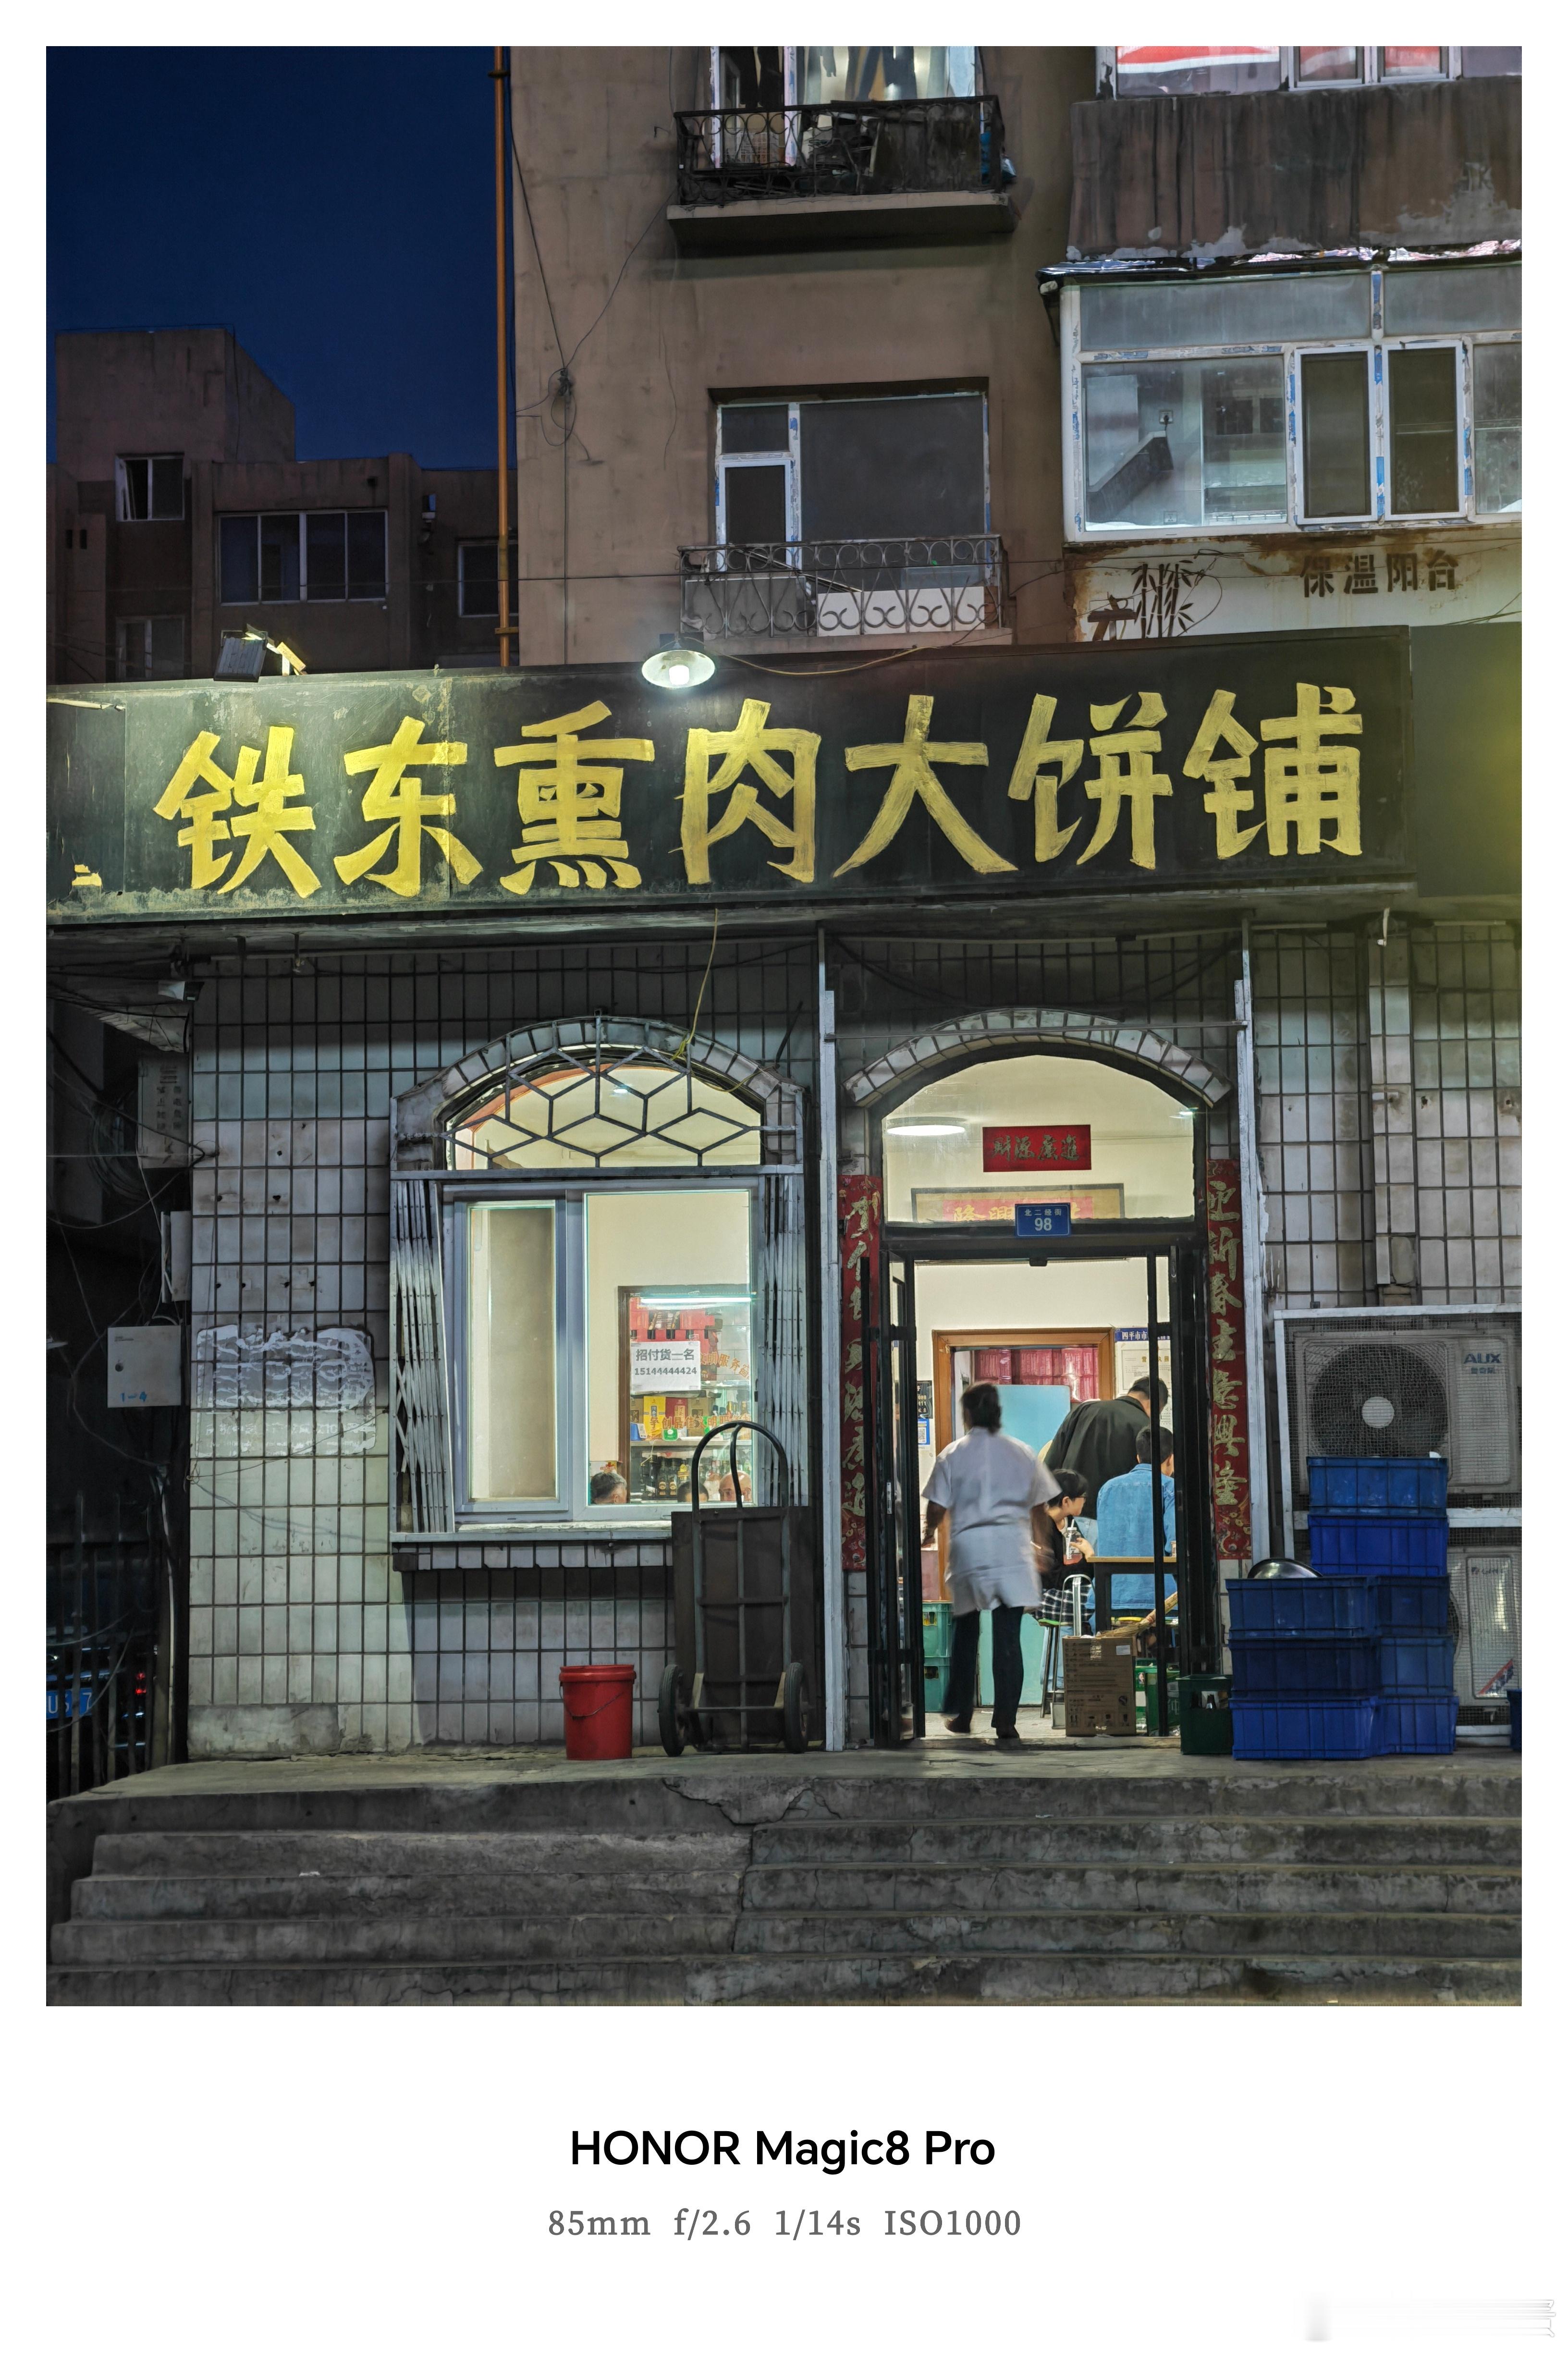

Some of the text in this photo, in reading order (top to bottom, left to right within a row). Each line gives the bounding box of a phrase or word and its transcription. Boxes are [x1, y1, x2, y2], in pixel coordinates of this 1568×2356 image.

[1299, 550, 1459, 598] 保温阳台
[153, 683, 1362, 897] 铁东熏肉大饼铺
[1024, 1208, 1062, 1216] 北二经街
[1034, 1217, 1053, 1231] 98
[1464, 1353, 1502, 1364] AUX
[634, 1367, 698, 1375] 15144444424
